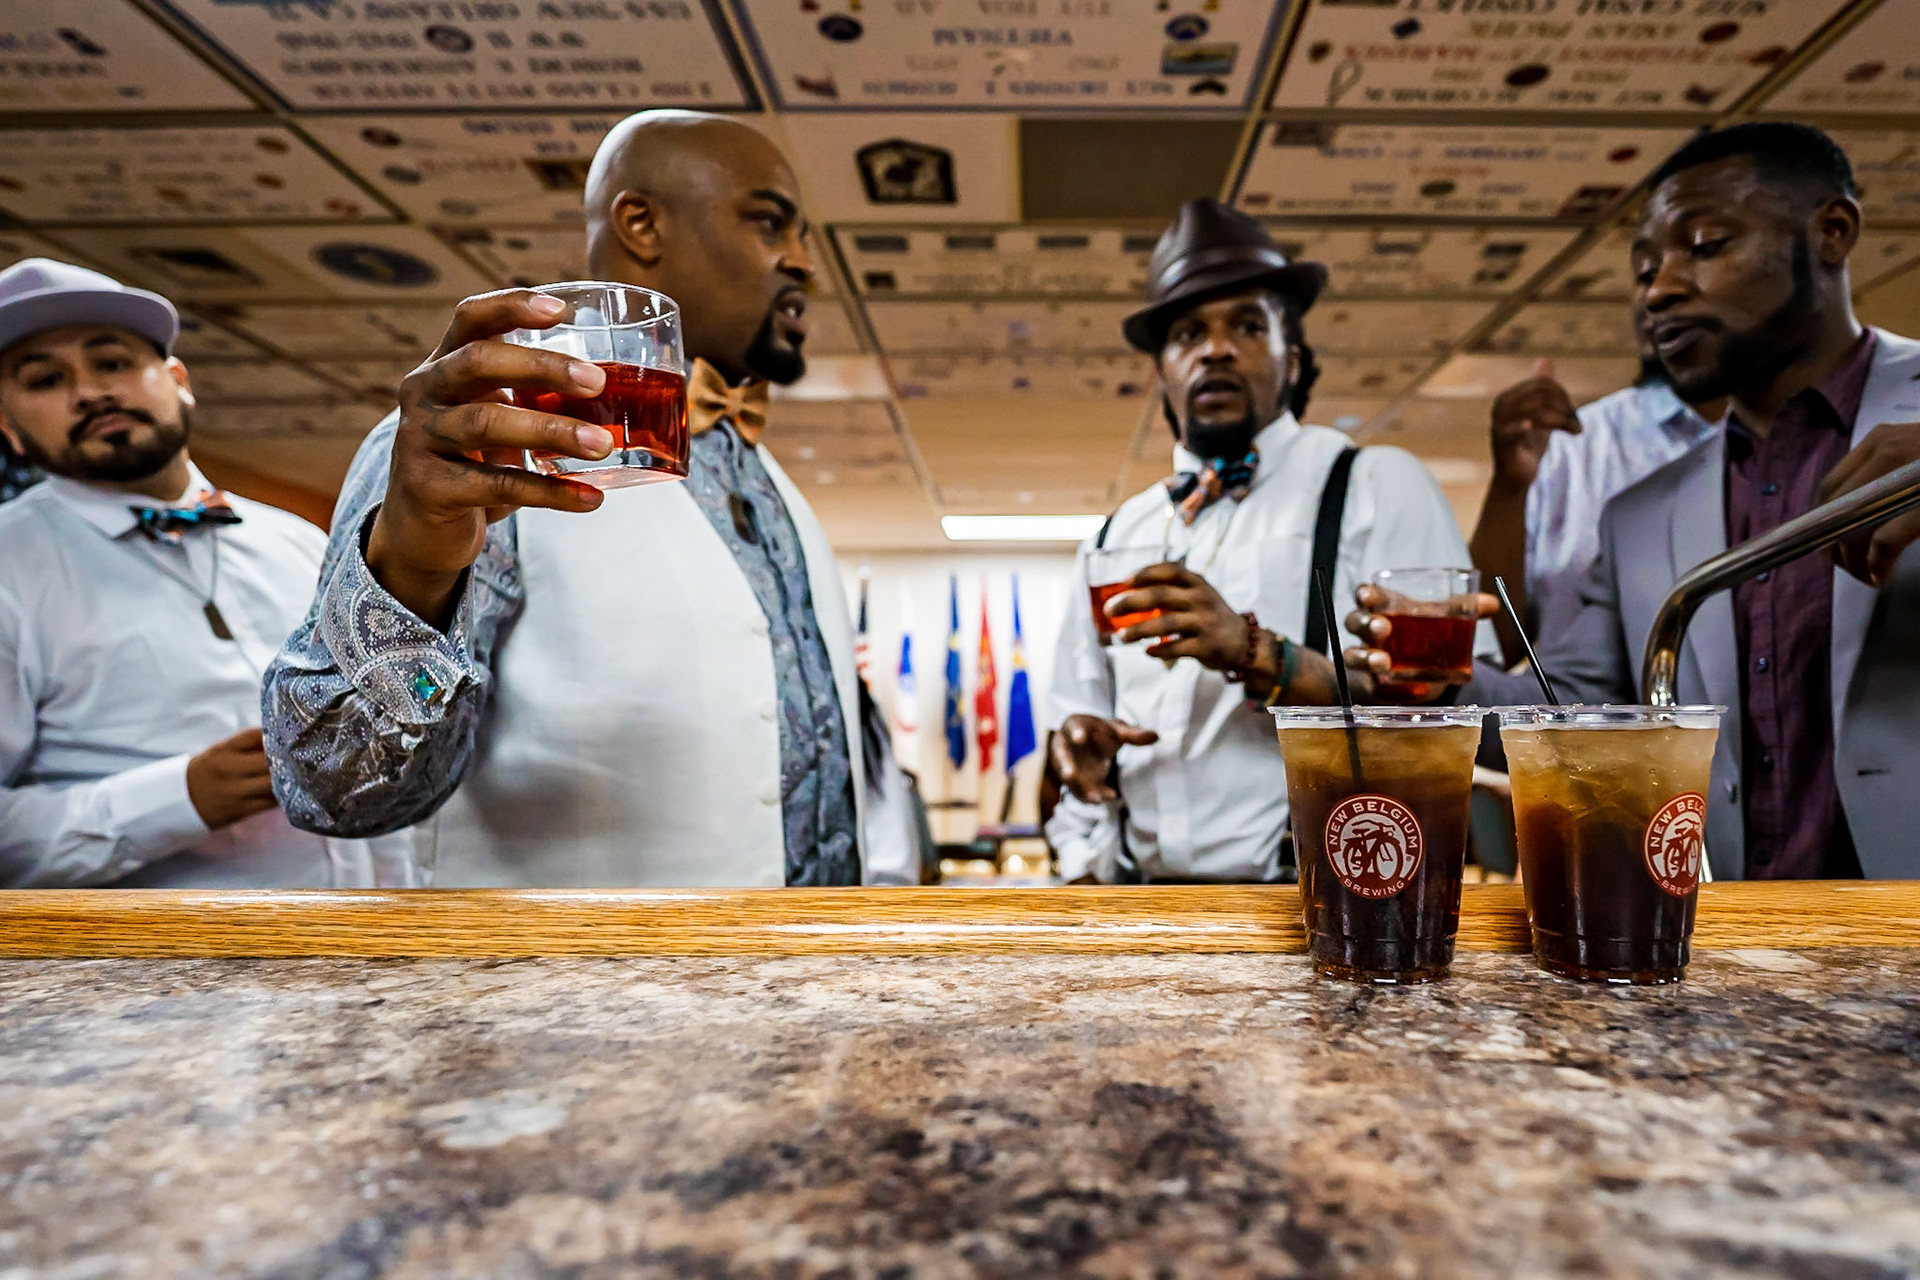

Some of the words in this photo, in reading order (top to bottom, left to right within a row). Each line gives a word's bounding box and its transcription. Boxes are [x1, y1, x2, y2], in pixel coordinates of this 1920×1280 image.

[932, 28, 1073, 46] VIETNAM
[1329, 809, 1348, 846] NEW
[1352, 801, 1418, 849] BELGIUM
[1650, 809, 1673, 848] NEW
[1343, 878, 1405, 896] BREWING
